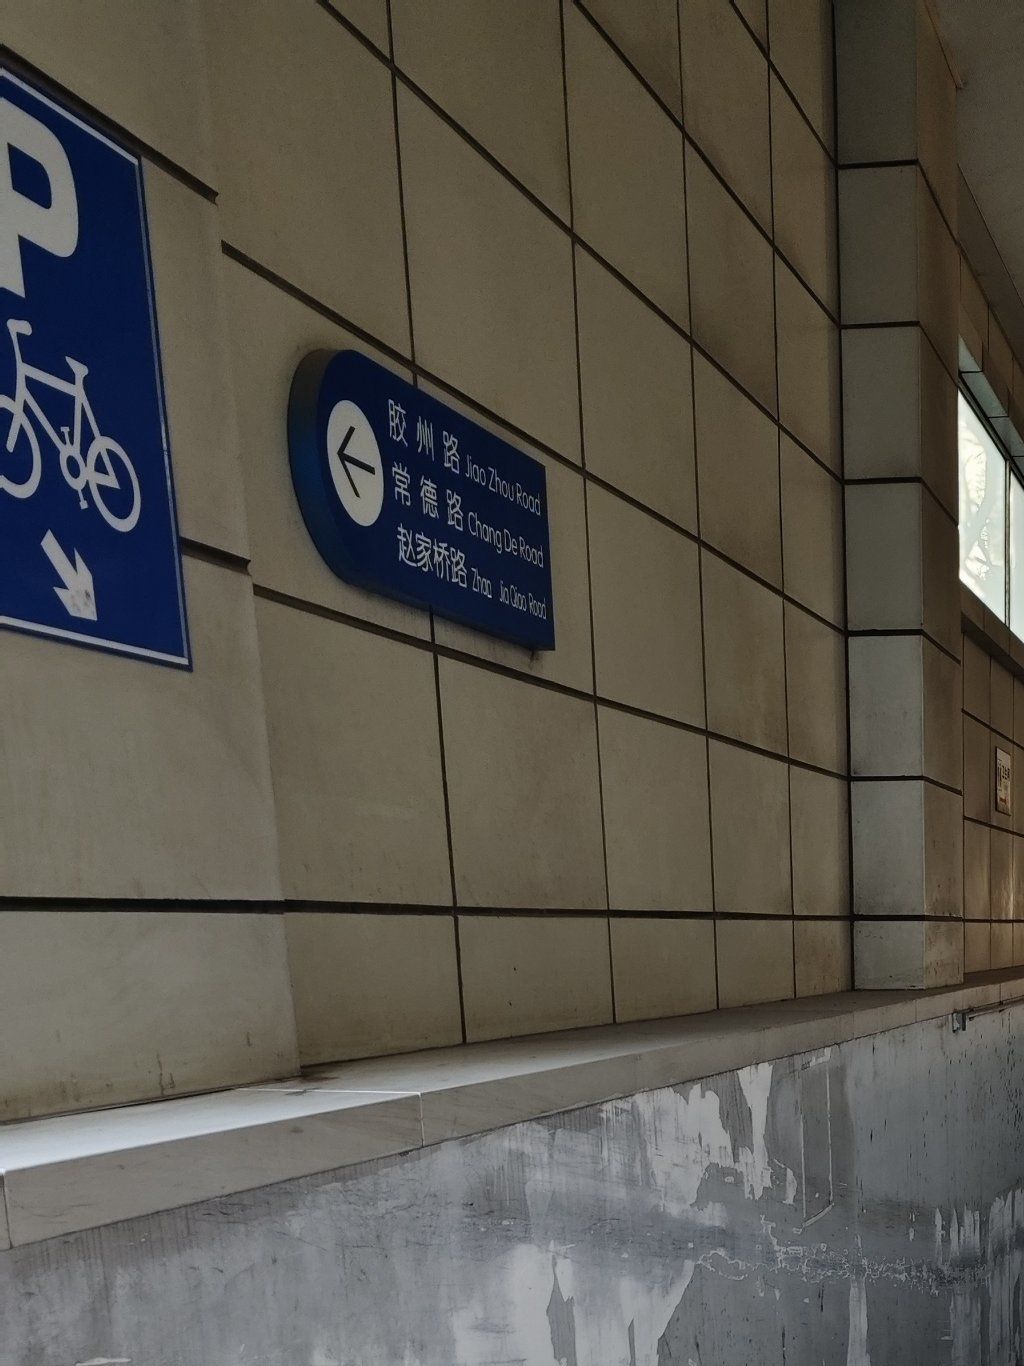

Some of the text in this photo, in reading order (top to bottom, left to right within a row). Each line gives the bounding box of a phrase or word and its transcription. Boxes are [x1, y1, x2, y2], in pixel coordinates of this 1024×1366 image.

[465, 454, 541, 516] Jiao Zhou Road
[397, 523, 468, 588] 赵家桥路
[468, 511, 544, 569] Chang De Road
[528, 592, 547, 620] Road
